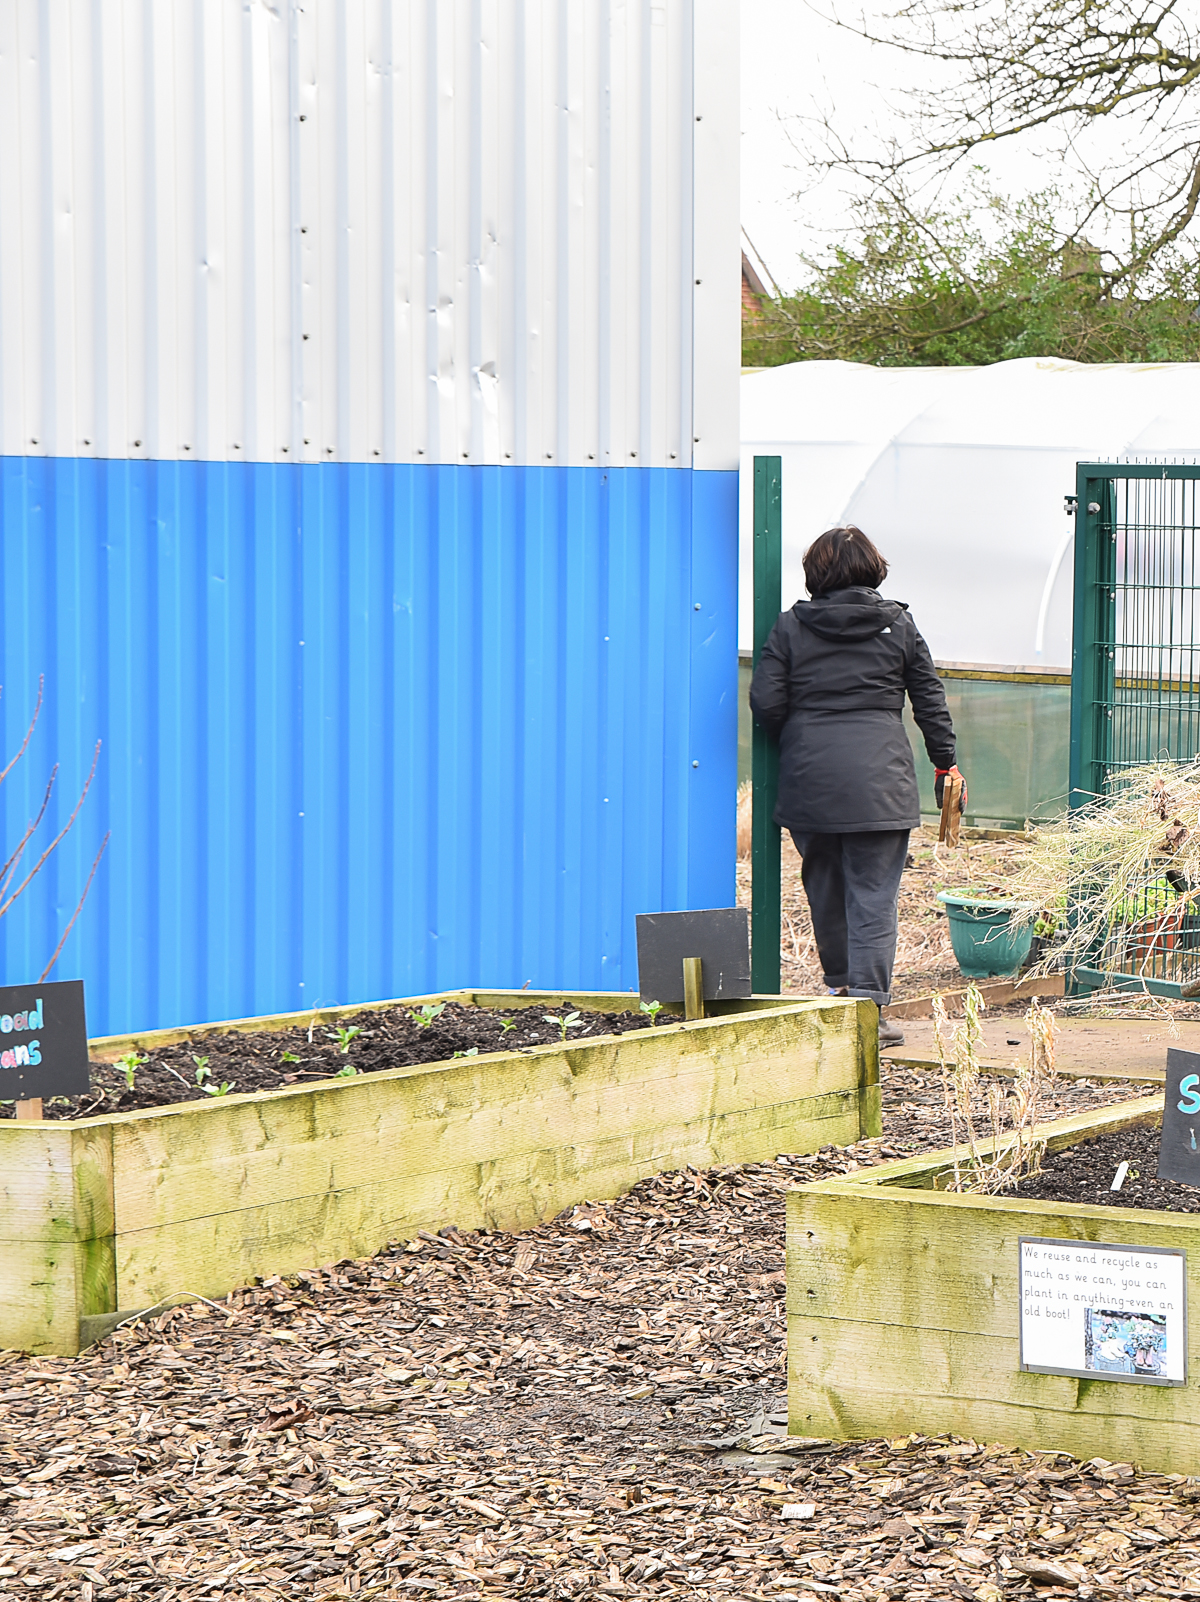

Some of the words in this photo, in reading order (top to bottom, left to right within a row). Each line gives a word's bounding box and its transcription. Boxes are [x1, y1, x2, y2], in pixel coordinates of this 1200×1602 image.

[0, 998, 44, 1034] oad
[0, 1040, 42, 1069] ans
[1023, 1246, 1039, 1259] We
[1043, 1251, 1071, 1262] reuse
[1075, 1253, 1097, 1264] and
[1102, 1256, 1141, 1271] recycle
[1145, 1262, 1158, 1270] as
[1024, 1268, 1053, 1280] much
[1057, 1273, 1070, 1281] as
[1074, 1274, 1088, 1283] we
[1092, 1277, 1116, 1287] can,
[1121, 1279, 1141, 1291] you
[1146, 1281, 1167, 1290] can
[1024, 1286, 1053, 1300] plant
[1057, 1290, 1068, 1300] in
[1159, 1301, 1174, 1310] an
[1024, 1304, 1041, 1317] old
[1045, 1306, 1071, 1320] boot!
